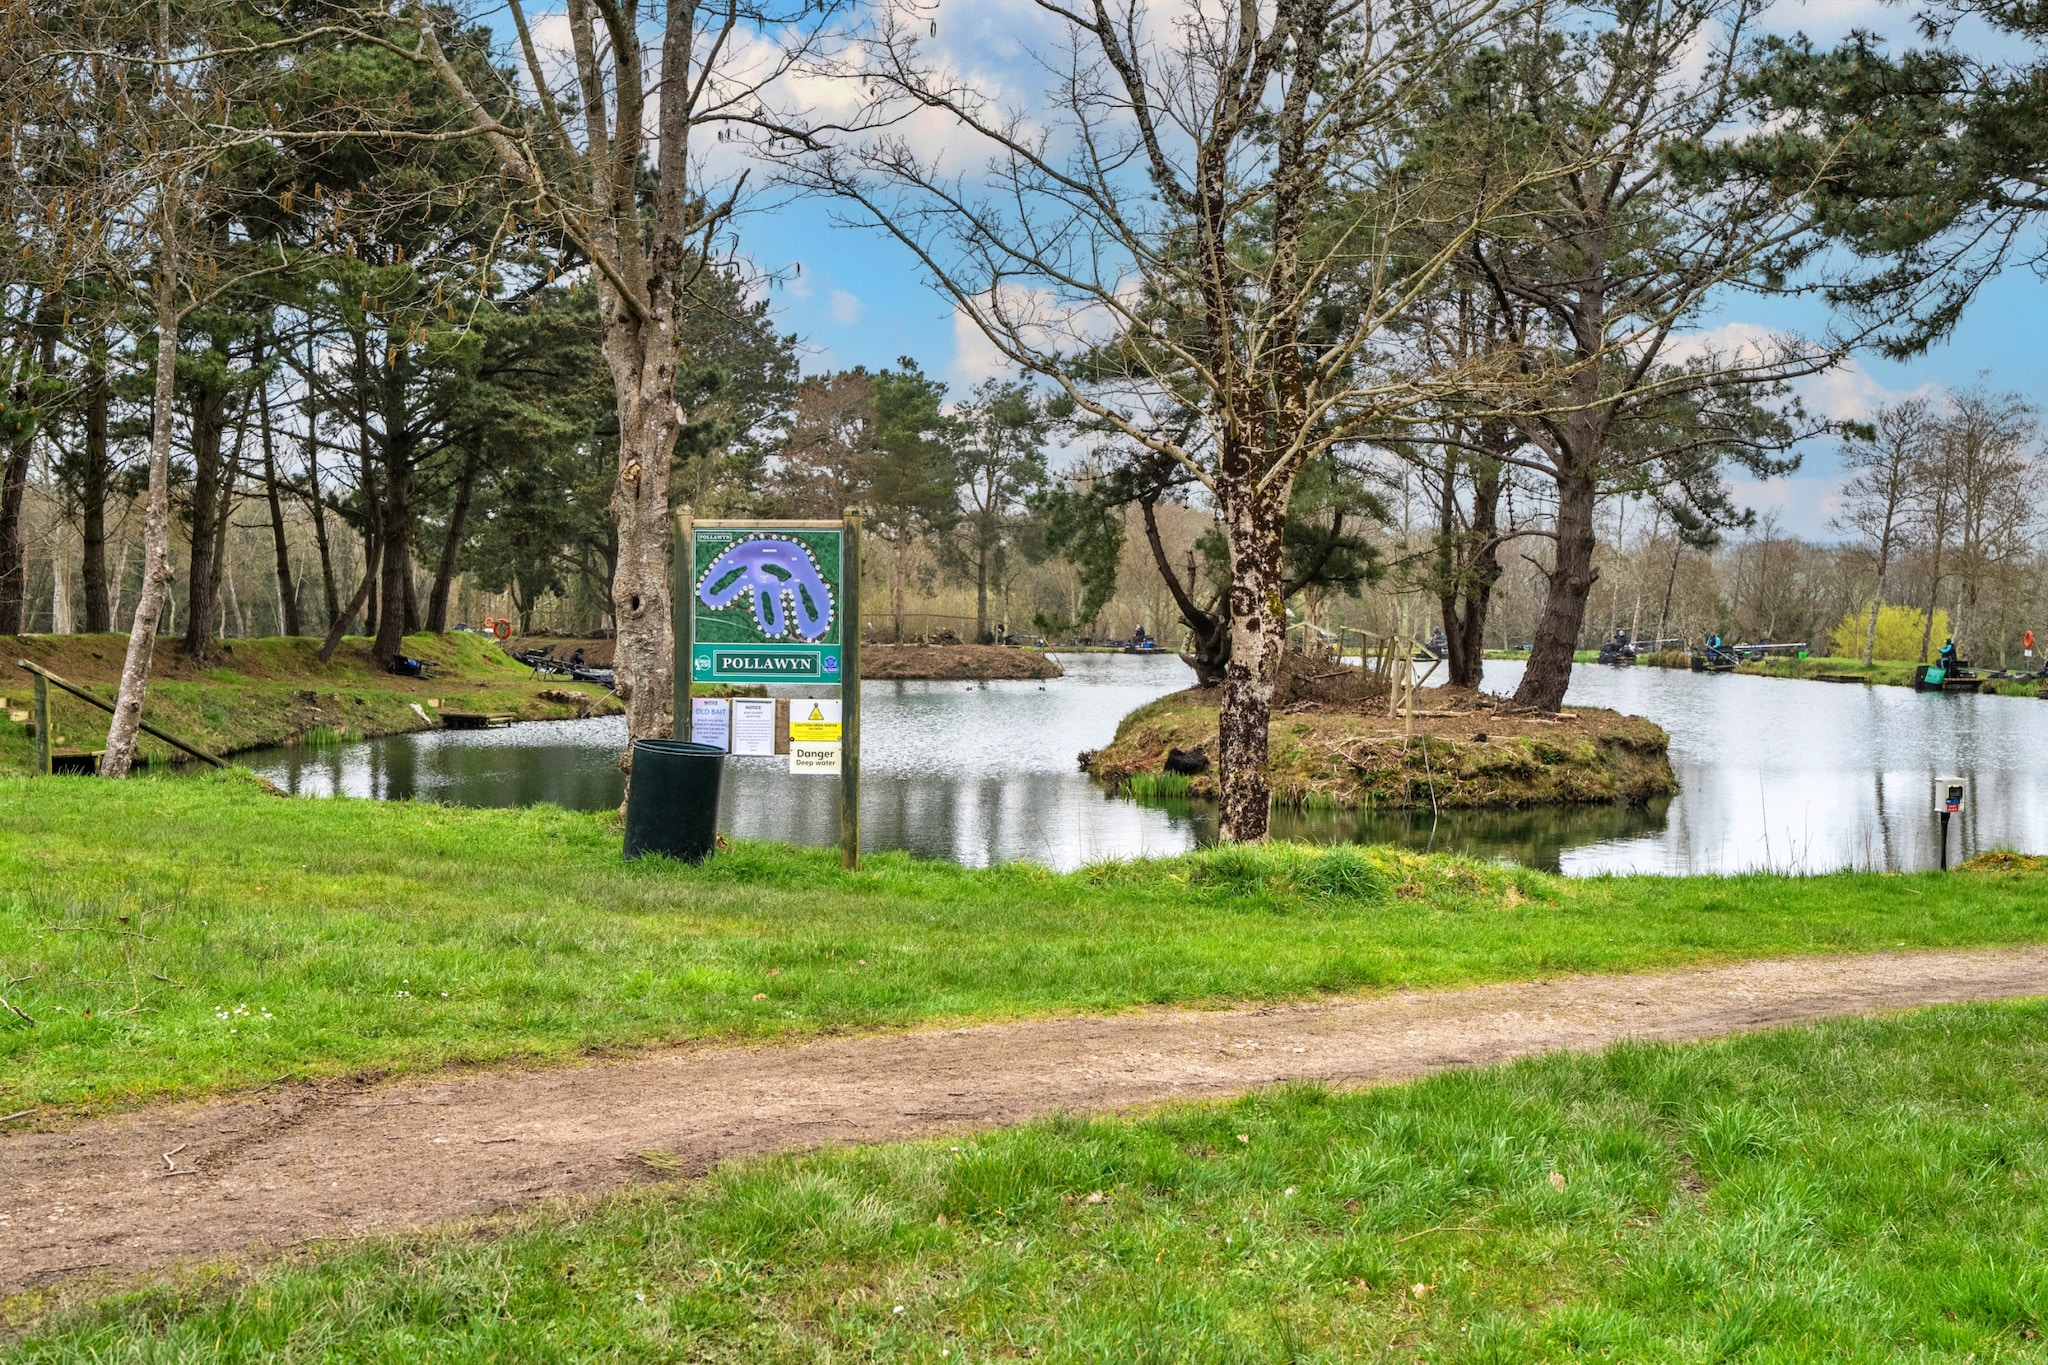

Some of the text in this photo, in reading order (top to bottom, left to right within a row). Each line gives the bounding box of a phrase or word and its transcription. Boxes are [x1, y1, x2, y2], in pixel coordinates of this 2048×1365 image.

[722, 657, 811, 669] POLLAWYN
[797, 749, 834, 760] Danger
[796, 759, 814, 767] Deep
